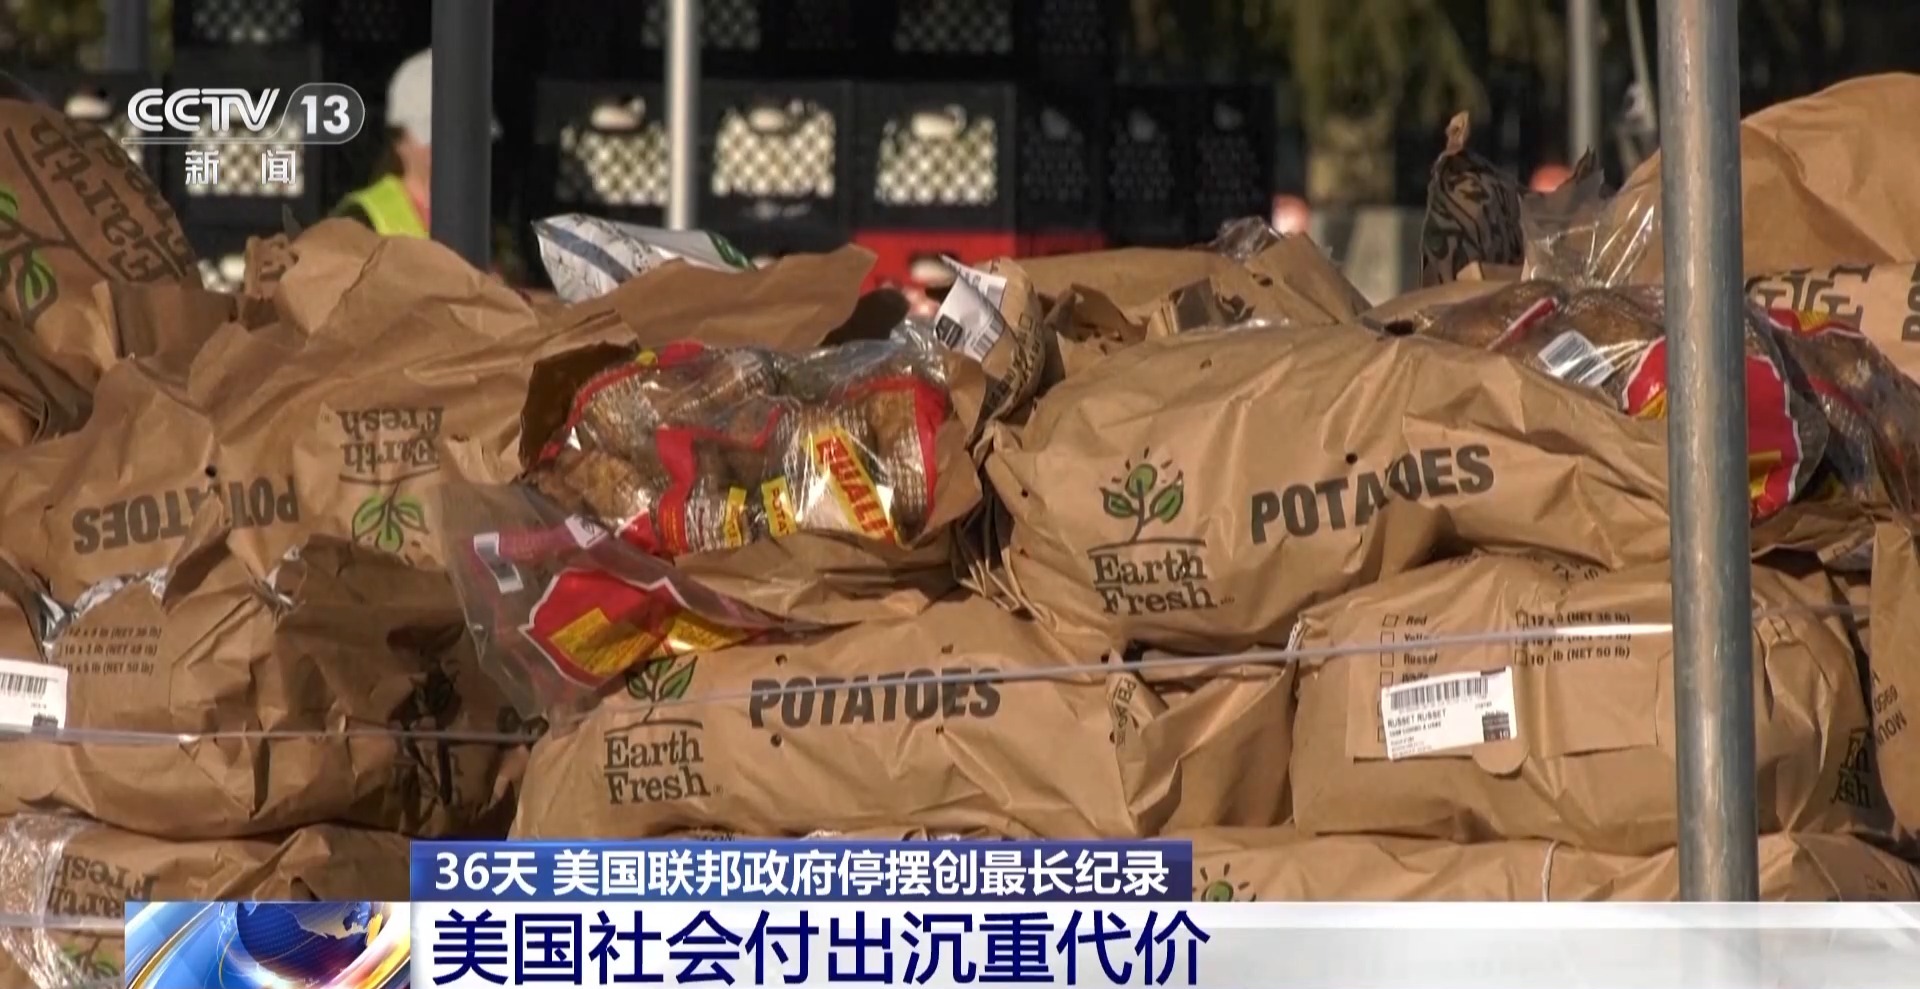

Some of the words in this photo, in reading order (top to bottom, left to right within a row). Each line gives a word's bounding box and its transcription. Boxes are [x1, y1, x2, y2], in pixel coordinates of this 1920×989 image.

[30, 117, 161, 282] Earth
[337, 407, 444, 437] Fresh
[340, 438, 441, 467] Earth
[1251, 444, 1494, 544] POTAOES
[1090, 549, 1208, 585] Earth
[1099, 581, 1217, 615] Fresh
[750, 667, 1002, 729] POTATOES
[604, 730, 704, 769] Earth
[606, 766, 709, 804] Fresh
